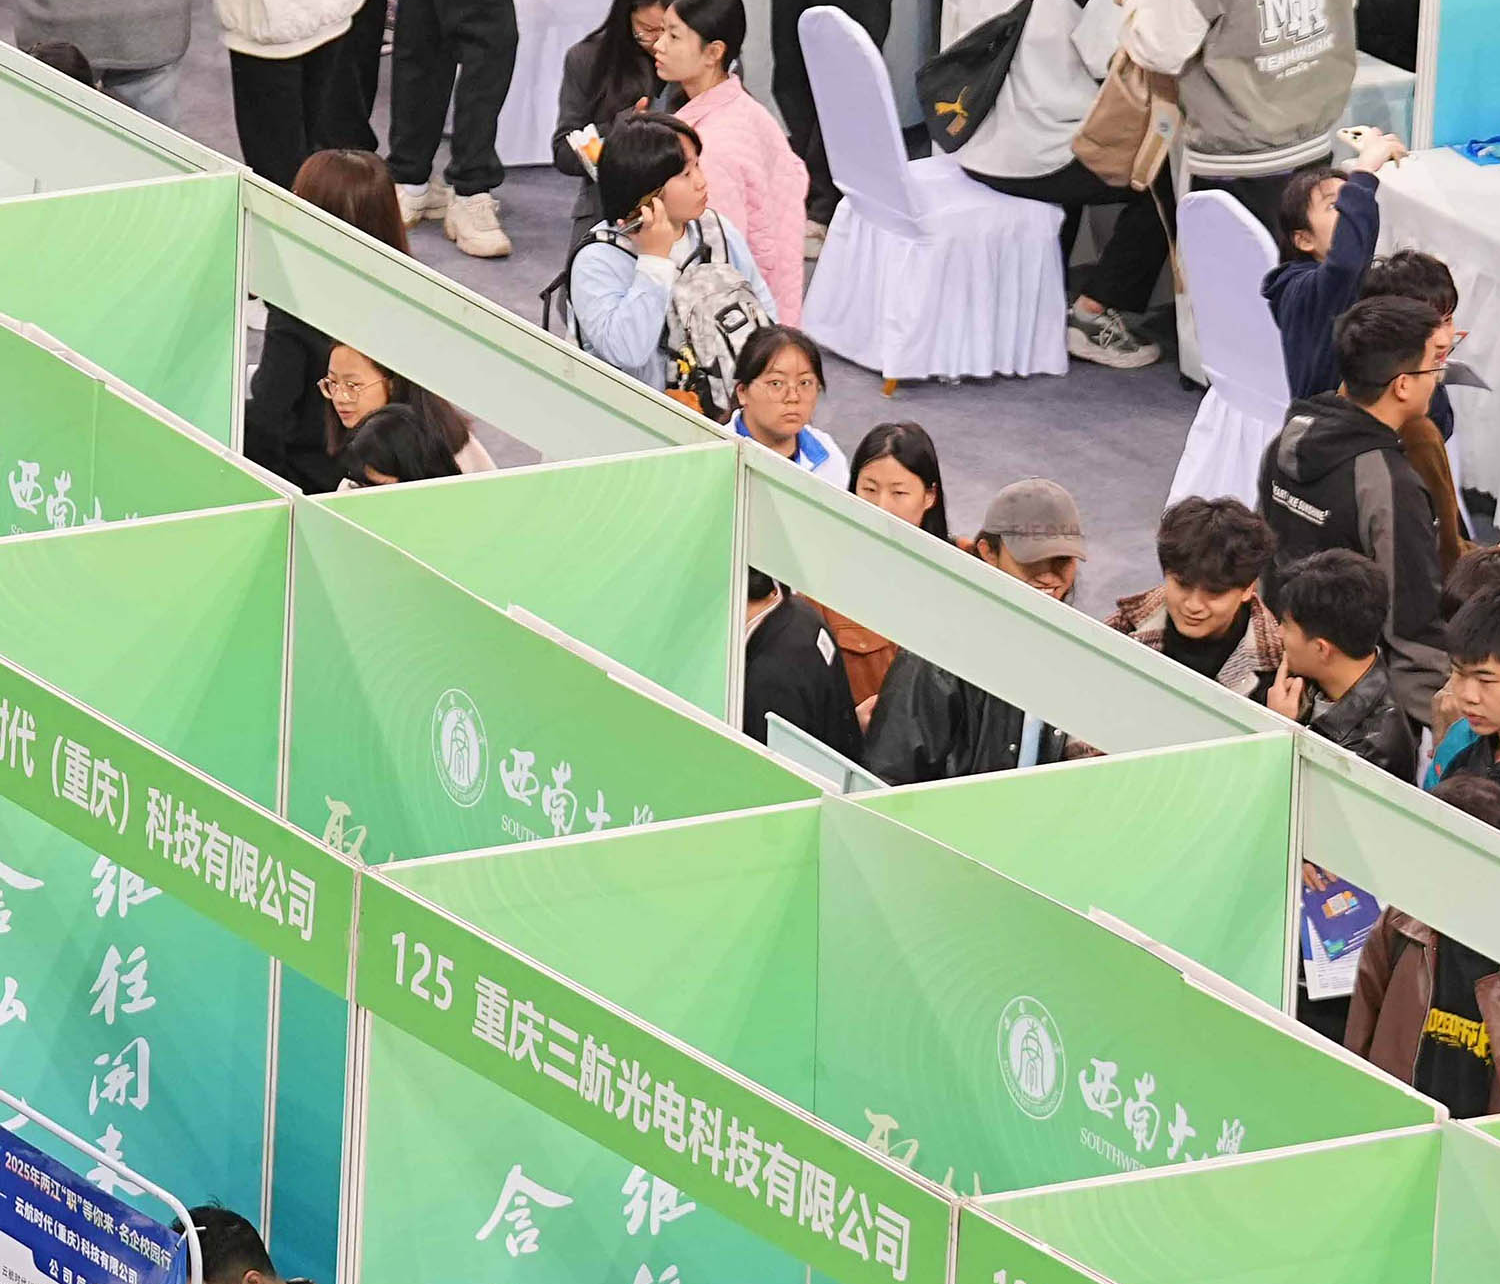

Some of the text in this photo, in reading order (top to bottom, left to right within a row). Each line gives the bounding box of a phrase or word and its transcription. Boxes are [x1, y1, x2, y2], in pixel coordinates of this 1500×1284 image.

[392, 934, 910, 1281] 125 重庆三航光电科技有限公司
